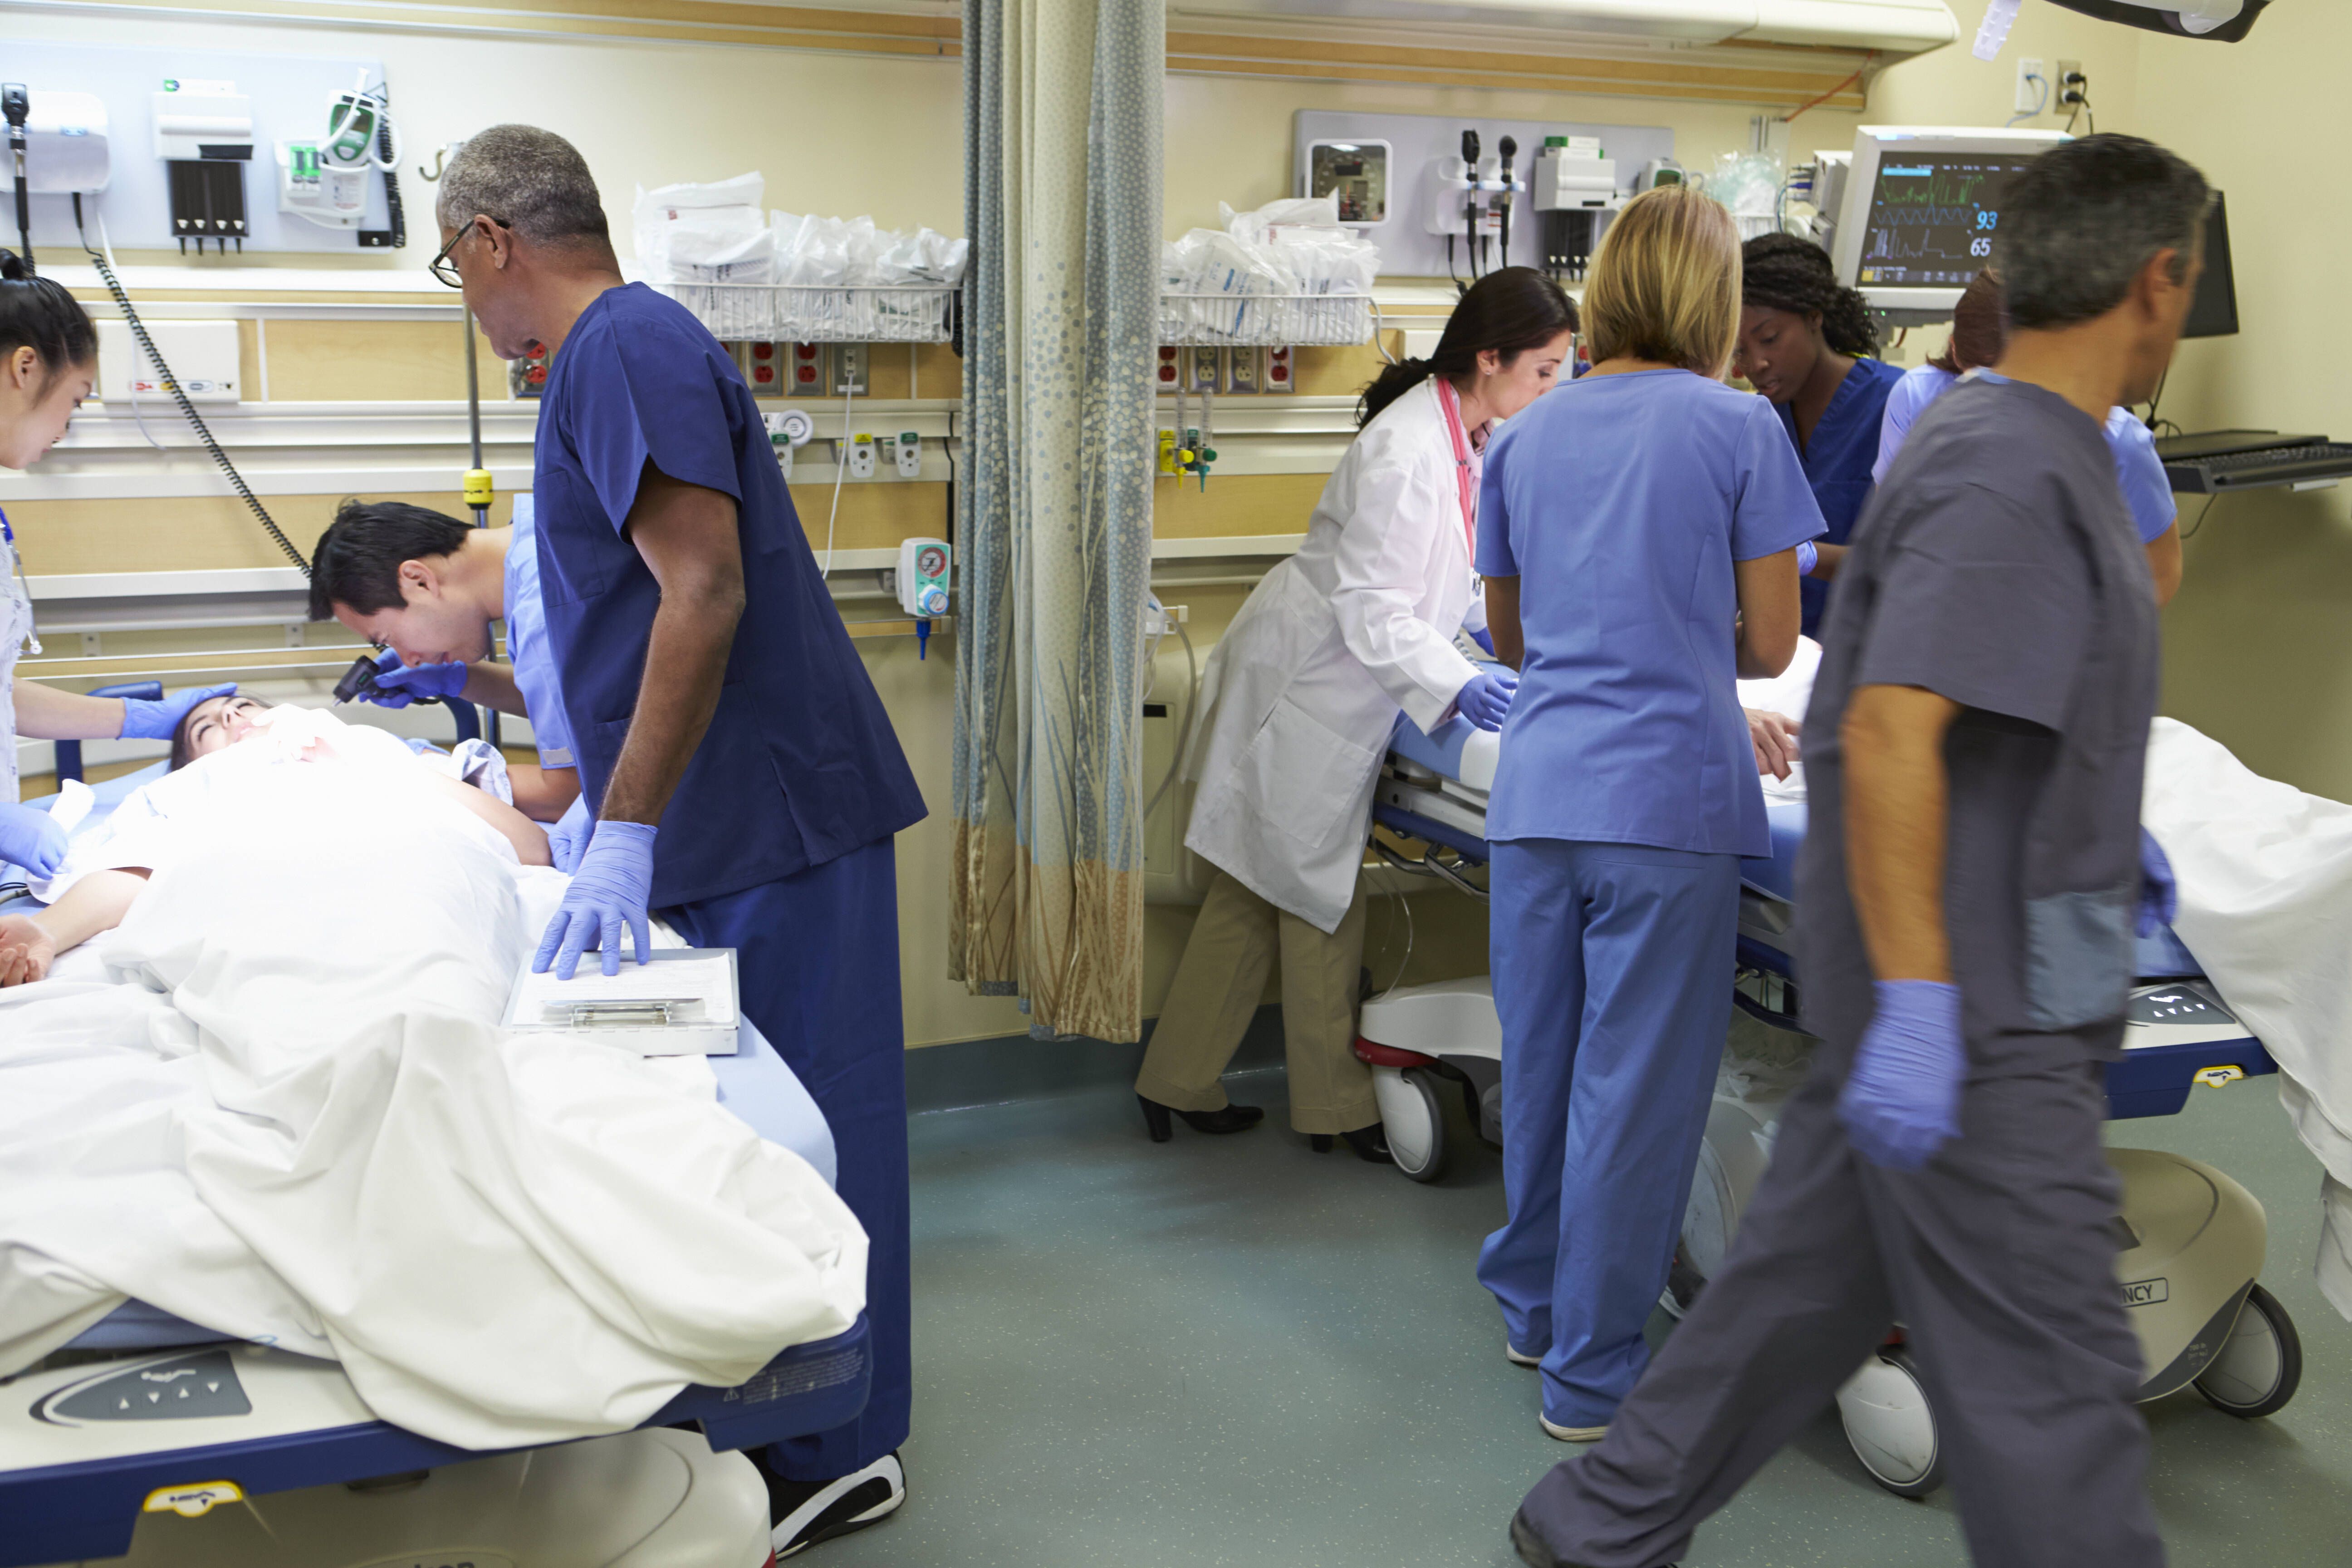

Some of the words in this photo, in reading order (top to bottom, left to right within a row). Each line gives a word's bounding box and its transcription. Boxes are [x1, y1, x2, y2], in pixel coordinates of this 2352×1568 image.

[1976, 210, 1998, 230] 93
[1970, 237, 1992, 257] 65
[2122, 1284, 2152, 1303] NCY
